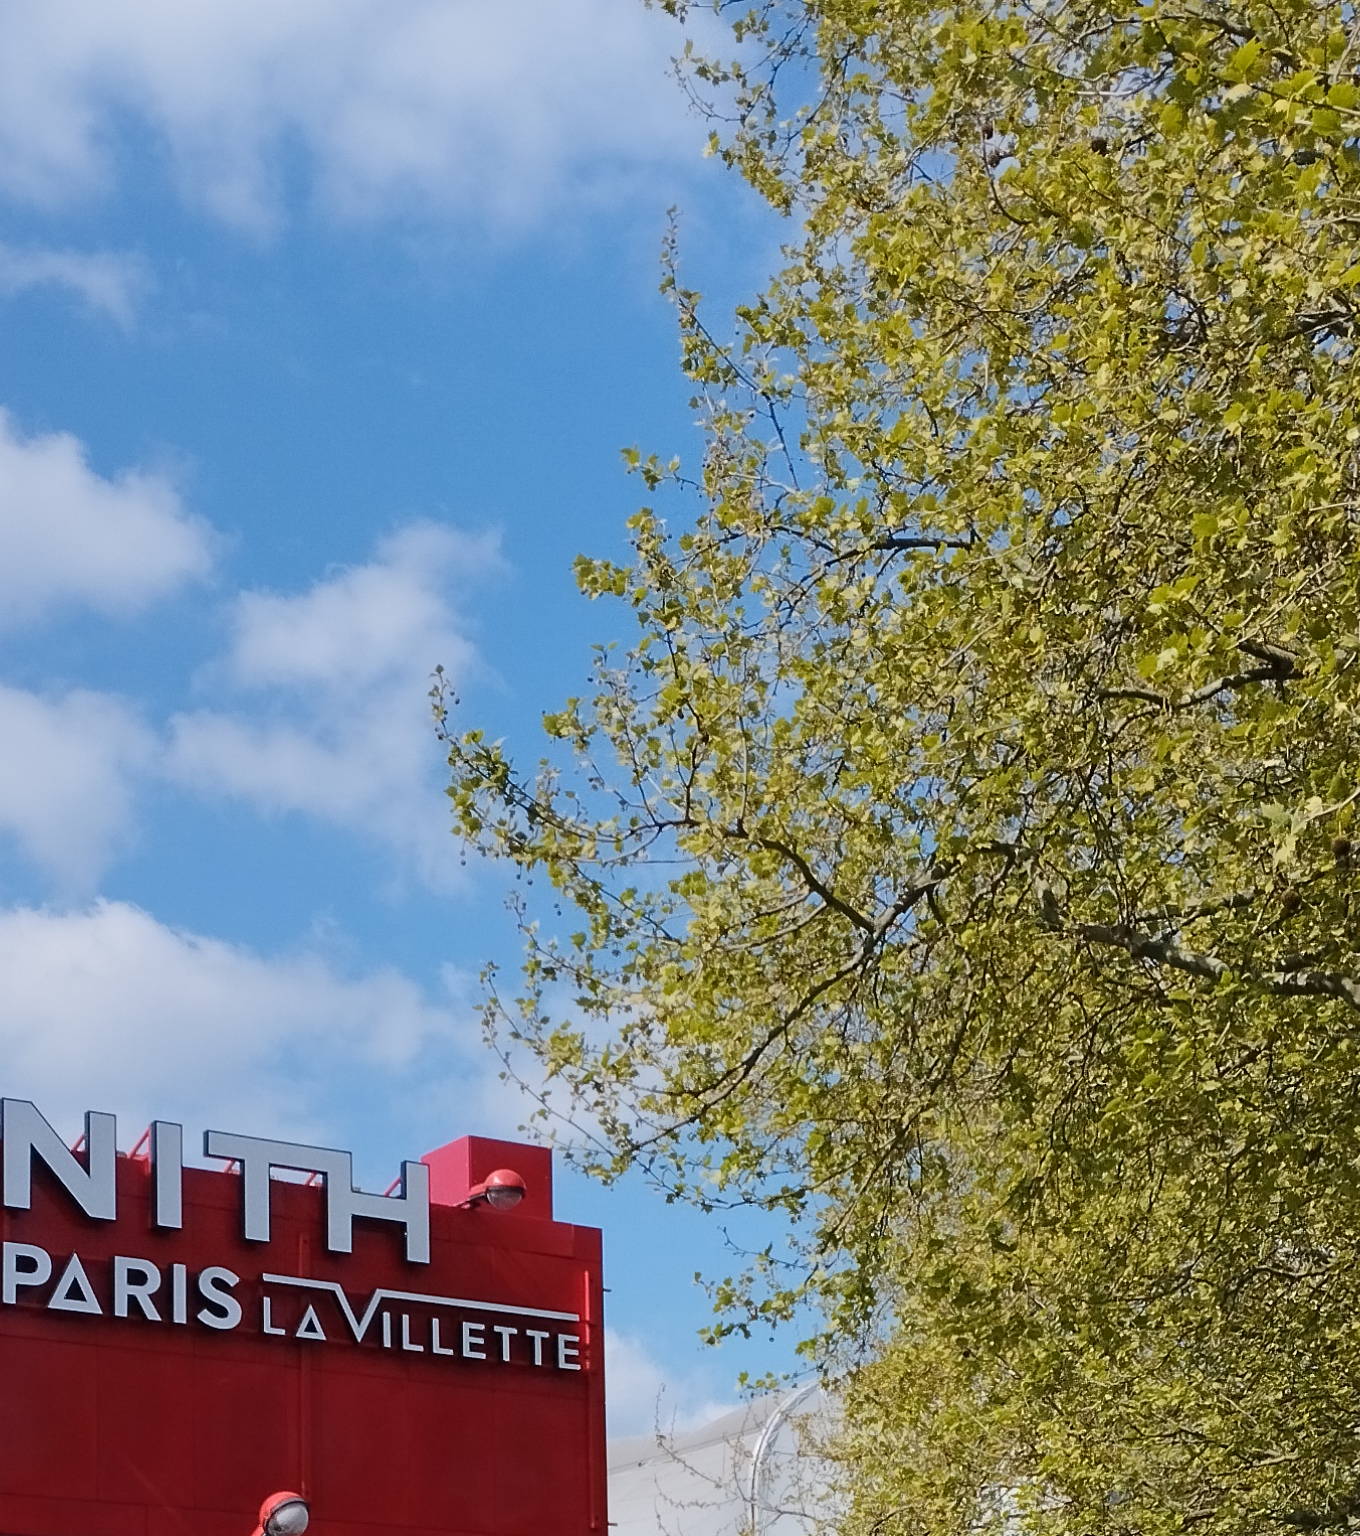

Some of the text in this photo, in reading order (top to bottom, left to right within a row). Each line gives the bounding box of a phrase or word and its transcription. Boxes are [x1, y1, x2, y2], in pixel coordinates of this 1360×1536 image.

[2, 1241, 582, 1372] PARIS LA VILLETTE
